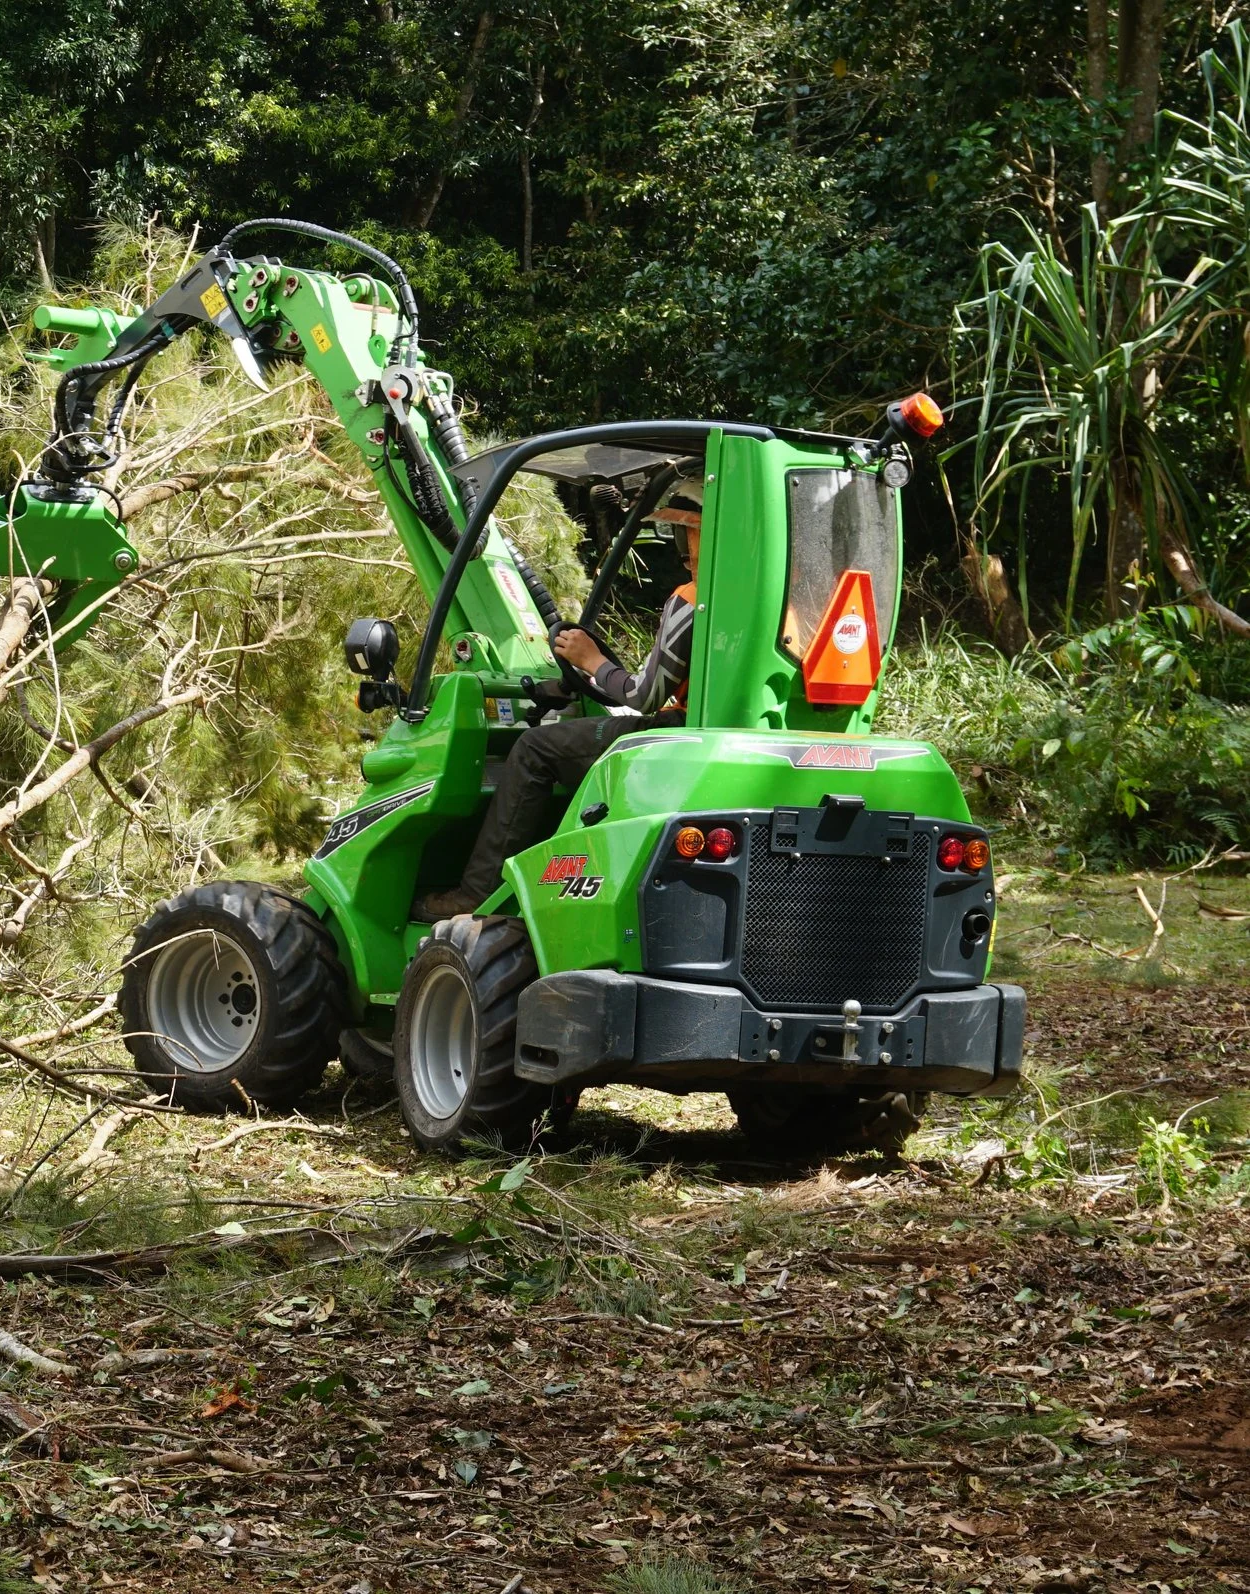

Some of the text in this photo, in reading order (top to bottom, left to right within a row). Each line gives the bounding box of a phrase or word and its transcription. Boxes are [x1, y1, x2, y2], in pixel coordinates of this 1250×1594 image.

[837, 623, 861, 637] AVANT
[796, 744, 872, 768] AVANT
[325, 815, 358, 842] 45
[538, 854, 588, 885] AVANT
[558, 876, 605, 899] 745
